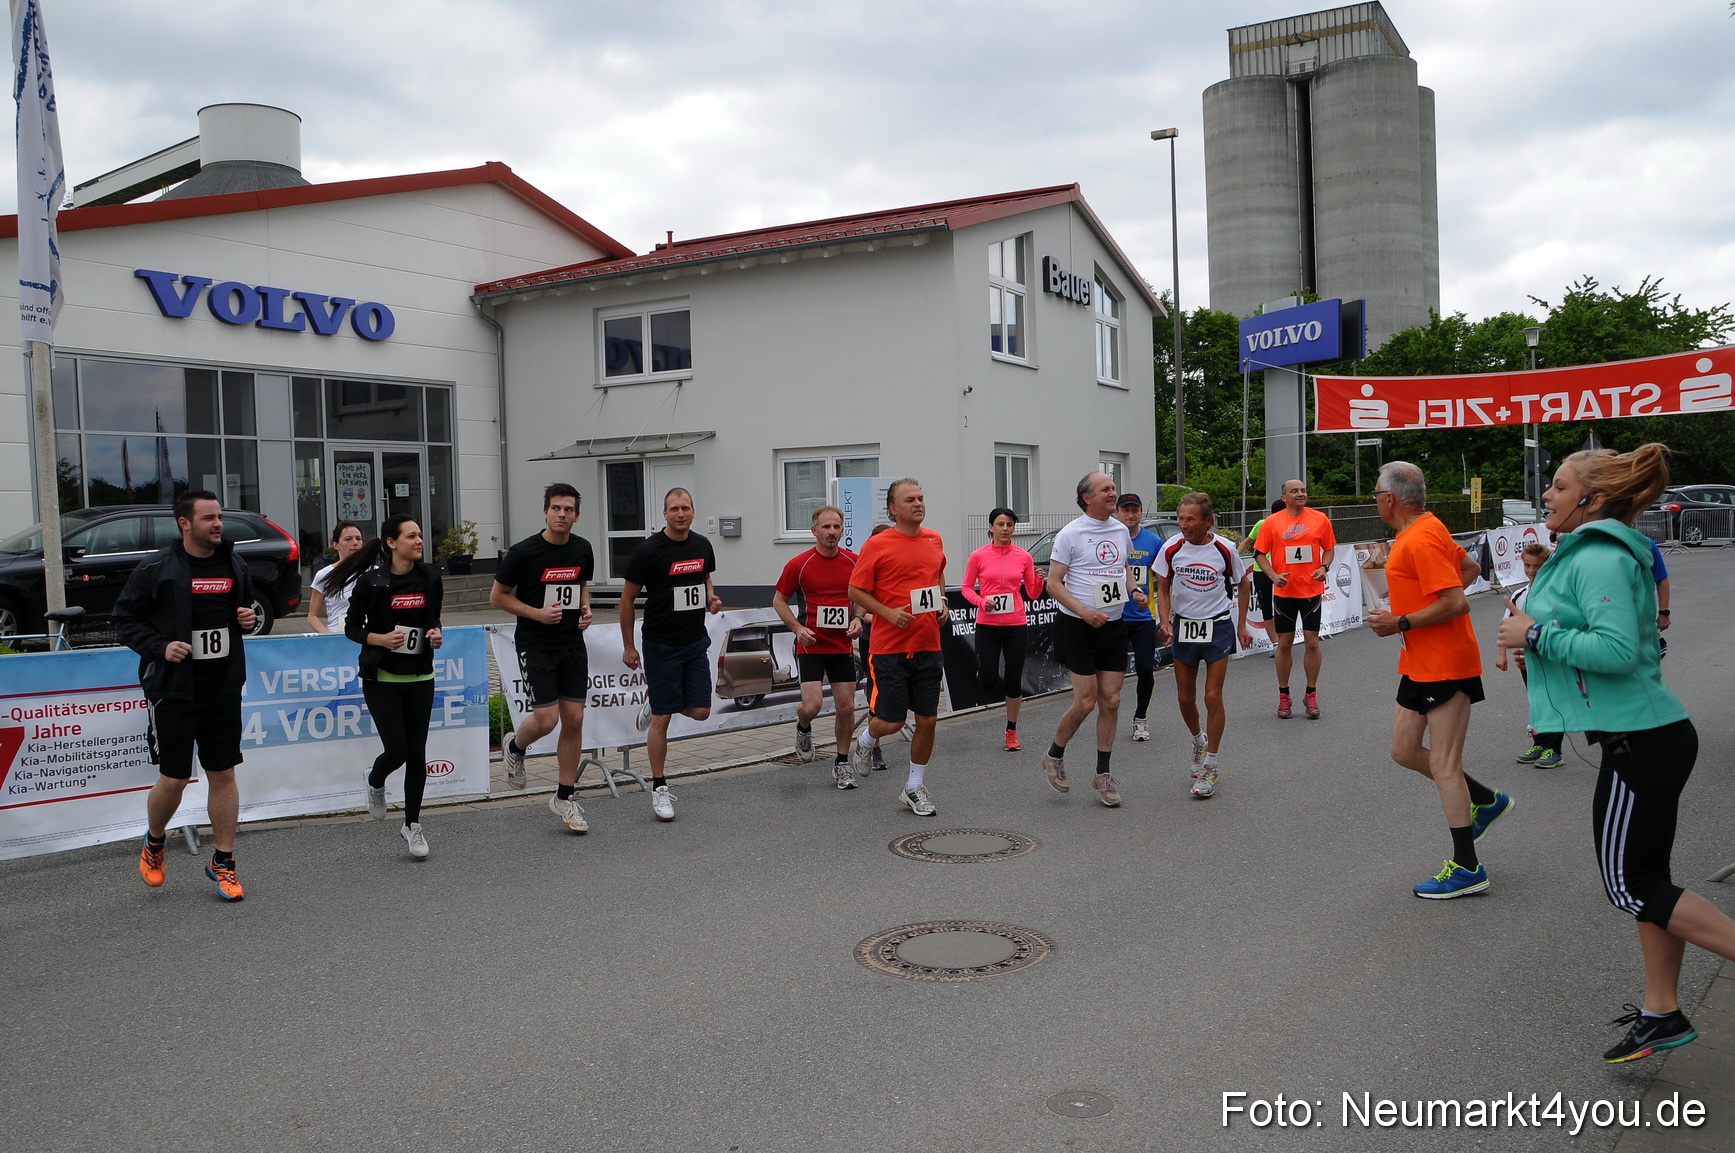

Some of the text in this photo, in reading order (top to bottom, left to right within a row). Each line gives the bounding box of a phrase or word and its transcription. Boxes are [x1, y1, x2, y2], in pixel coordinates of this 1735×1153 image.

[1042, 255, 1095, 307] Bauer
[134, 269, 396, 342] VOLVO
[21, 313, 37, 323] hilft
[1246, 320, 1323, 352] VOLVO
[1294, 546, 1303, 561] 4
[1175, 566, 1211, 576] GERHART
[555, 585, 572, 607] 19
[683, 586, 700, 607] 16
[919, 588, 934, 610] 41
[1101, 581, 1122, 604] 34
[993, 595, 1008, 612] 37
[822, 607, 845, 626] 123
[949, 608, 967, 622] DER
[1183, 621, 1208, 640] 104
[200, 630, 222, 655] 18
[591, 692, 627, 708] SEAT
[32, 722, 82, 740] Jahre
[242, 711, 268, 745] 4
[427, 763, 449, 774] KIA
